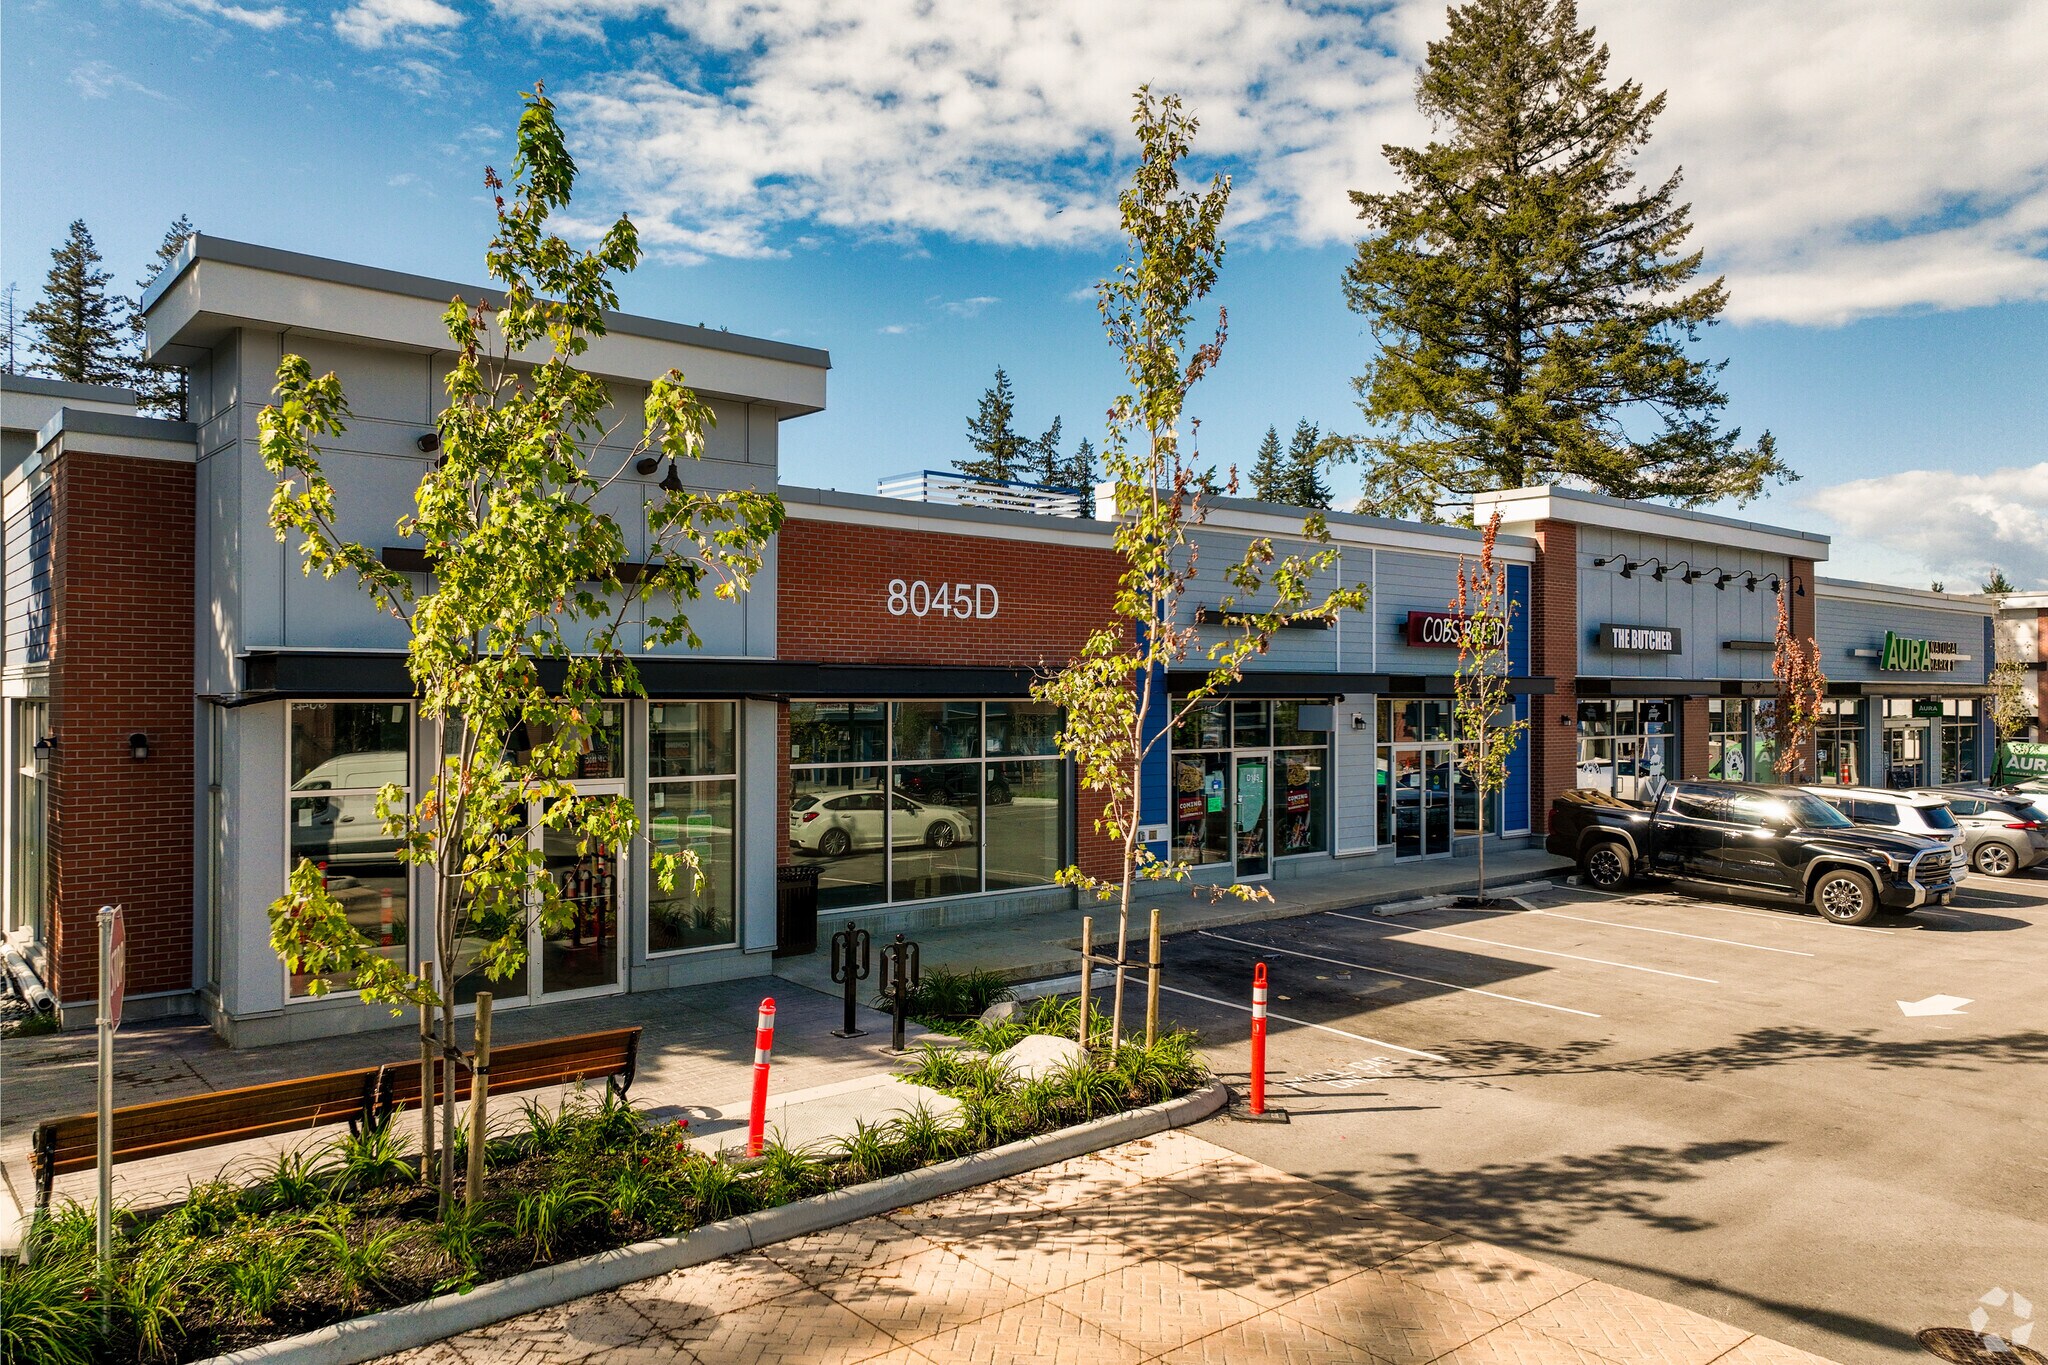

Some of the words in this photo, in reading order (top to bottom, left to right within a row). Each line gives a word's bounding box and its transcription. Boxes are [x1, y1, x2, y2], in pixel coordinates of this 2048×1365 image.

[887, 578, 999, 619] 8045D
[1423, 616, 1460, 643] COBS
[1612, 628, 1630, 649] THE
[1631, 629, 1672, 651] BUTCHER
[1881, 631, 1931, 671] AURA
[1918, 704, 1938, 712] AURA
[2006, 753, 2048, 772] AUR
[1179, 800, 1203, 809] COMING
[1287, 793, 1308, 802] COMING
